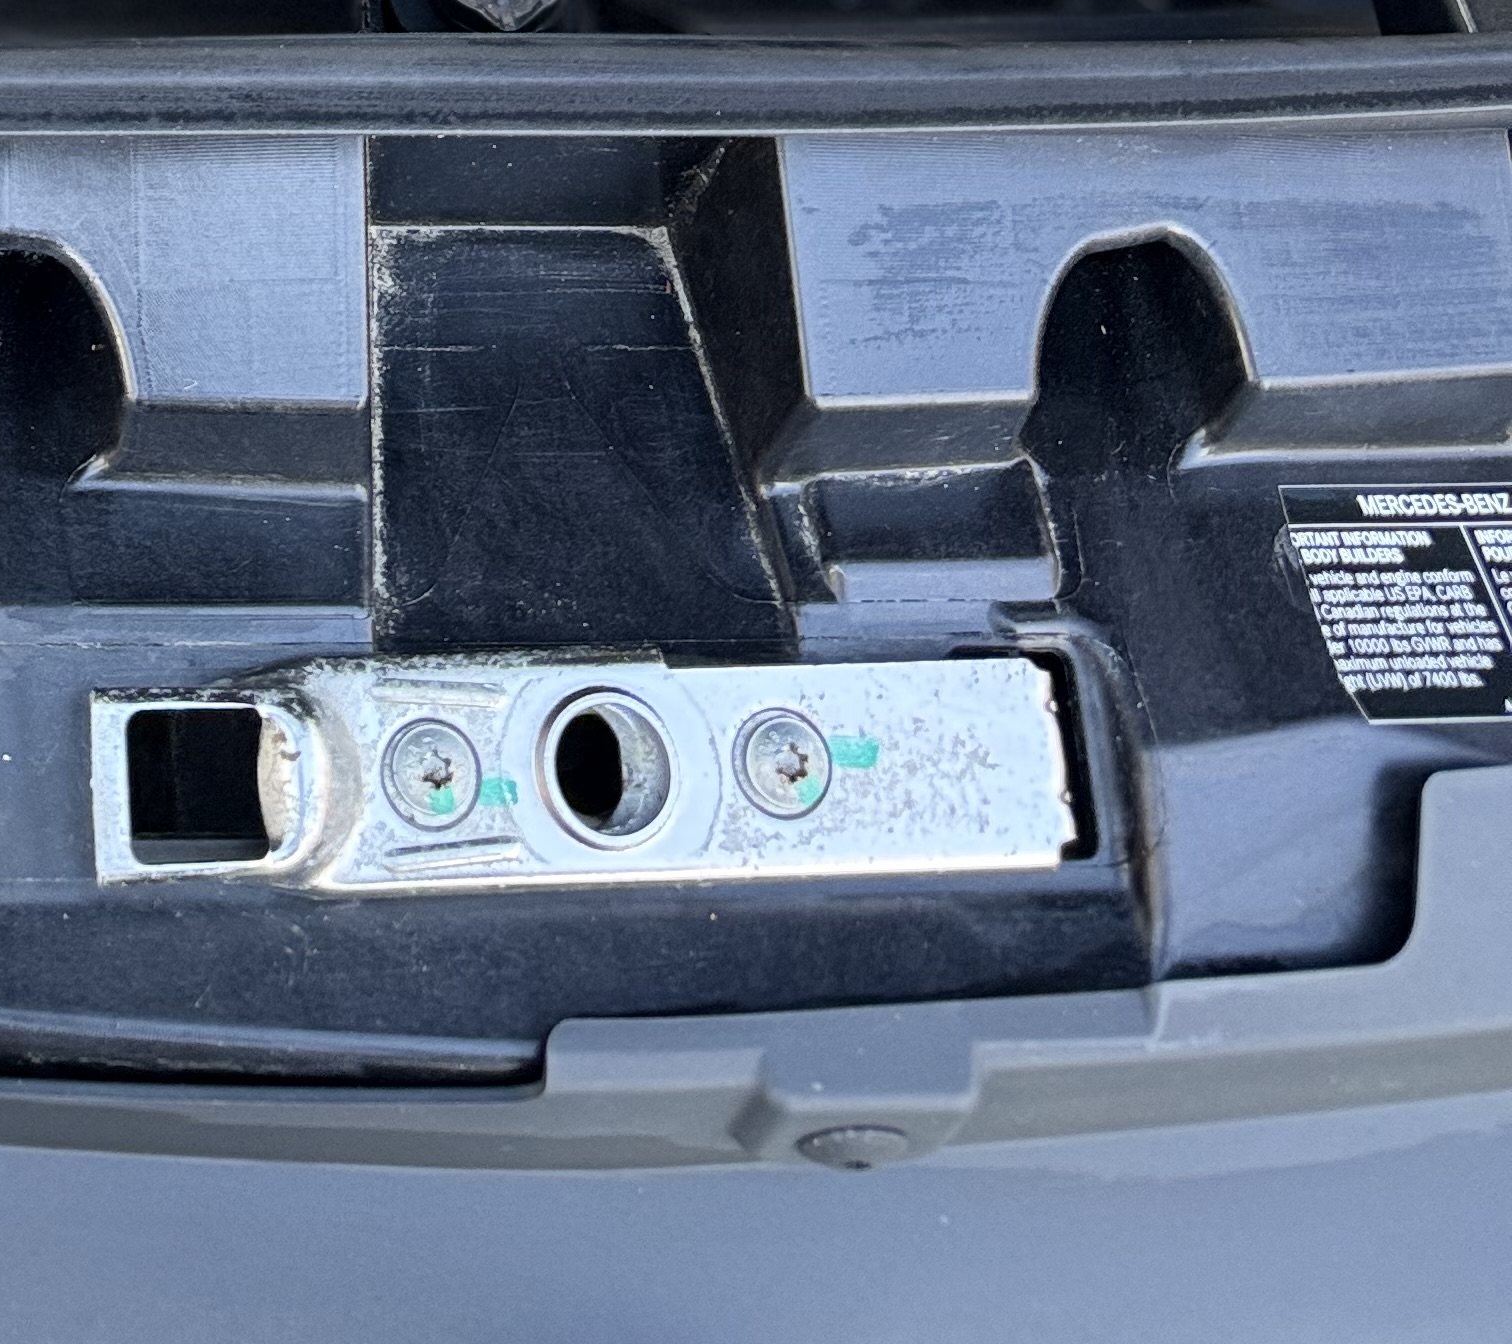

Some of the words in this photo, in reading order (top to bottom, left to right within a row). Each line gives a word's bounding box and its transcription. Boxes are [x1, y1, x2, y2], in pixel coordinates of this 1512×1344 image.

[1356, 493, 1512, 517] MERCEDES-BENZ
[1340, 530, 1433, 547] INFORMATION
[1299, 548, 1339, 564] BODY
[1339, 547, 1405, 564] BUILDERS
[1308, 569, 1354, 586] vehicle
[1354, 569, 1380, 586] and
[1379, 568, 1422, 587] engine
[1422, 567, 1476, 583] conform
[1322, 586, 1386, 604] applicable
[1383, 585, 1407, 602] US
[1435, 584, 1474, 601] CARB
[1320, 603, 1381, 620] Canadian
[1380, 602, 1449, 621] regulations
[1449, 602, 1464, 618] at
[1463, 601, 1488, 617] the
[1332, 620, 1347, 638] of
[1348, 620, 1426, 637] manufacture
[1425, 618, 1445, 635] for
[1445, 618, 1499, 635] vehicles
[1348, 637, 1390, 655] 10000
[1389, 637, 1412, 653] lbs
[1410, 635, 1452, 653] GVWR
[1452, 636, 1478, 652] and
[1476, 636, 1504, 652] has
[1389, 653, 1448, 670] unloaded
[1365, 671, 1409, 693] (UVW)
[1407, 671, 1423, 688] of
[1422, 670, 1459, 688] 7400
